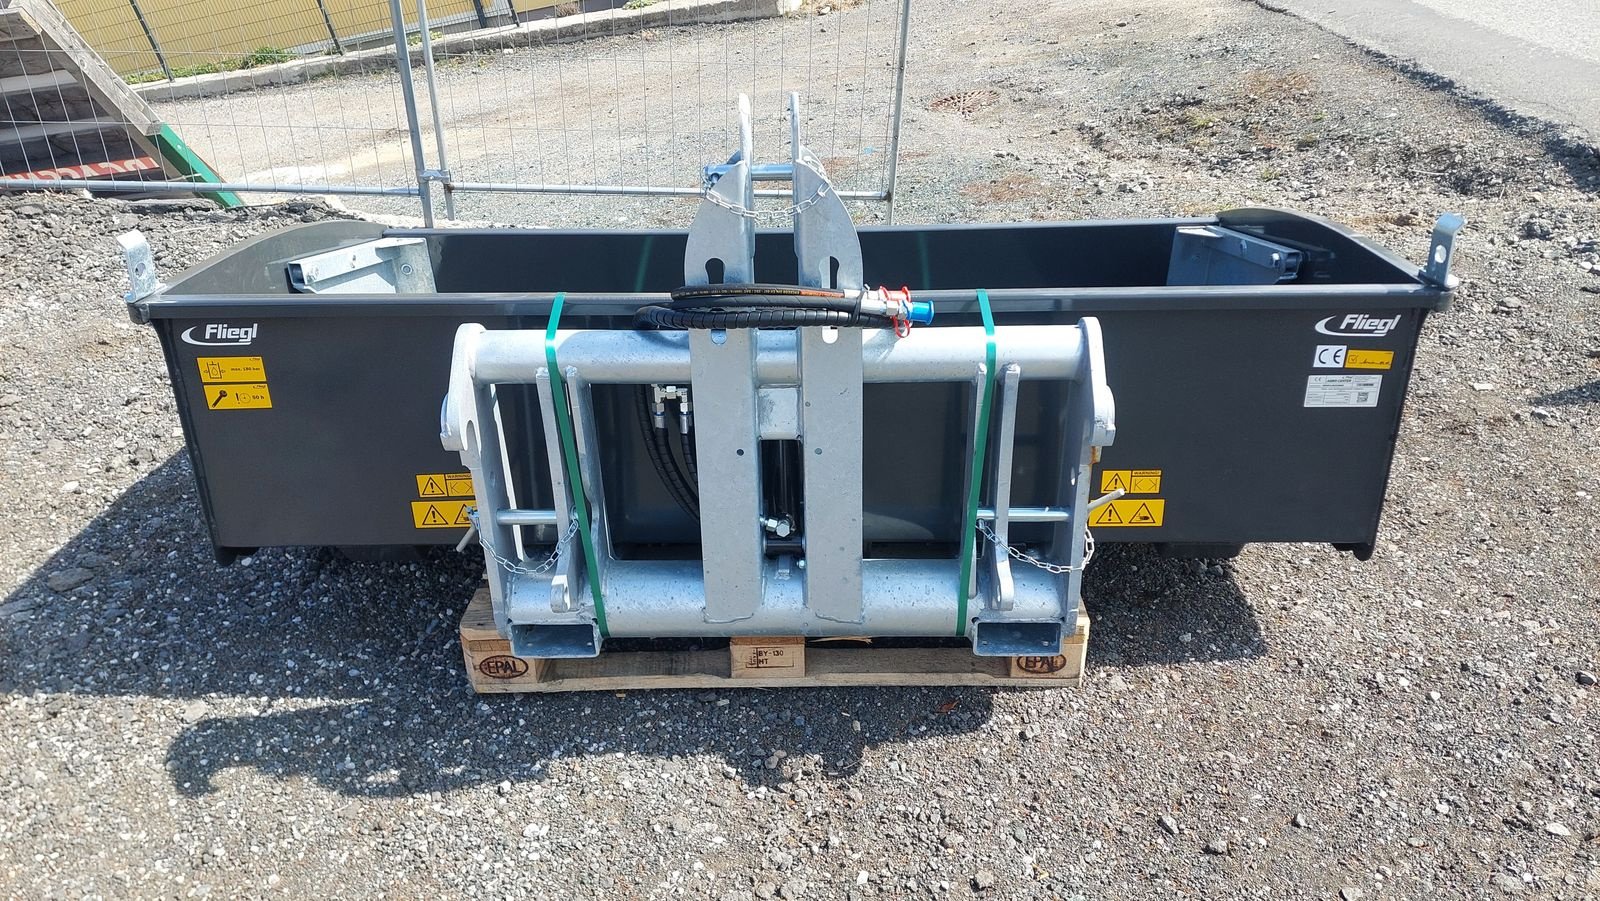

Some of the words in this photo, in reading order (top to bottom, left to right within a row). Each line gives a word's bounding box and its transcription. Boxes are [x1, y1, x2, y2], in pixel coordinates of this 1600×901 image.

[1340, 314, 1401, 333] Fliegl
[205, 323, 258, 342] Fliegl
[1318, 348, 1343, 364] CE
[487, 660, 522, 674] EPAL
